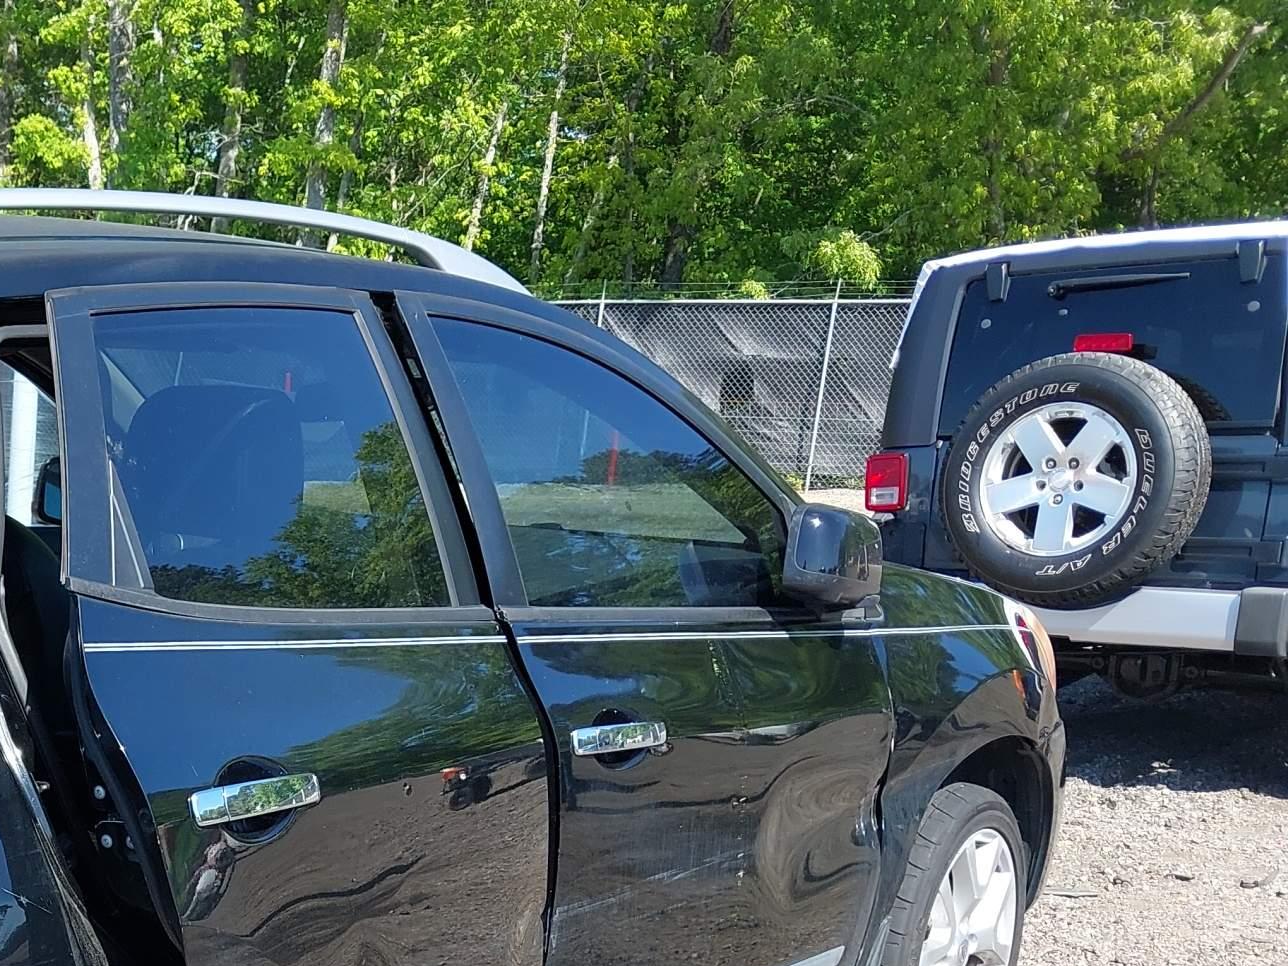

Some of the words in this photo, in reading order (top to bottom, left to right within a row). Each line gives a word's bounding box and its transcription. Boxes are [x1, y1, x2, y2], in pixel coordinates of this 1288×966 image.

[958, 383, 1079, 534] BRIDGESTONE
[1102, 428, 1155, 555] DUELER
[1035, 554, 1091, 576] A/T
